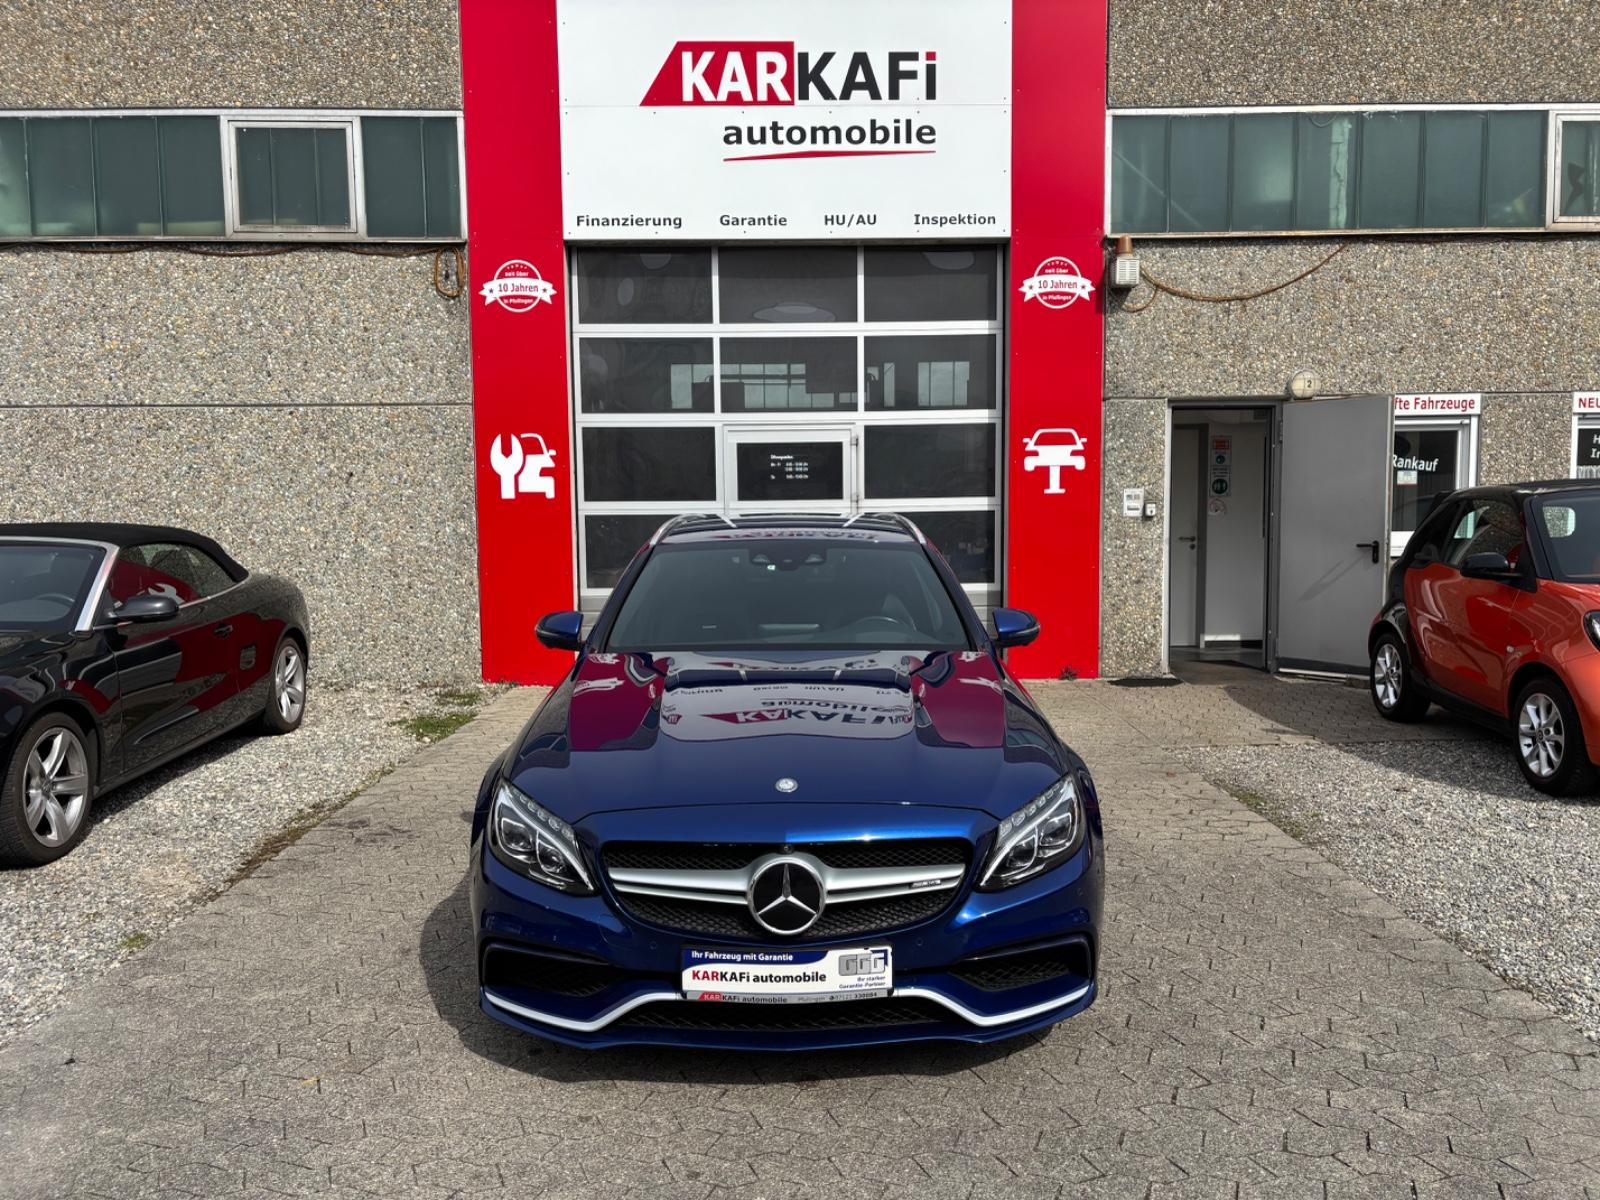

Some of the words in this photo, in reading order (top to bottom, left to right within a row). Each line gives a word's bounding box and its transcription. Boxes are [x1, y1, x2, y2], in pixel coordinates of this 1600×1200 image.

[722, 119, 937, 145] automobile
[576, 214, 682, 229] Finanzierung
[719, 214, 788, 227] Garantie
[823, 214, 878, 227] HU/AU
[913, 212, 997, 227] Inspektion
[498, 283, 508, 292] 10
[511, 283, 538, 292] Jahren
[1038, 280, 1048, 289] 10
[1050, 280, 1078, 289] Jahren
[1414, 397, 1475, 412] Fahrzeuge
[691, 951, 703, 959] Ihr
[704, 951, 742, 962] Fahrzeug
[743, 952, 757, 961] mit
[758, 953, 794, 961] Garantie
[692, 970, 750, 982] KARKAFi
[753, 971, 827, 983] automobile
